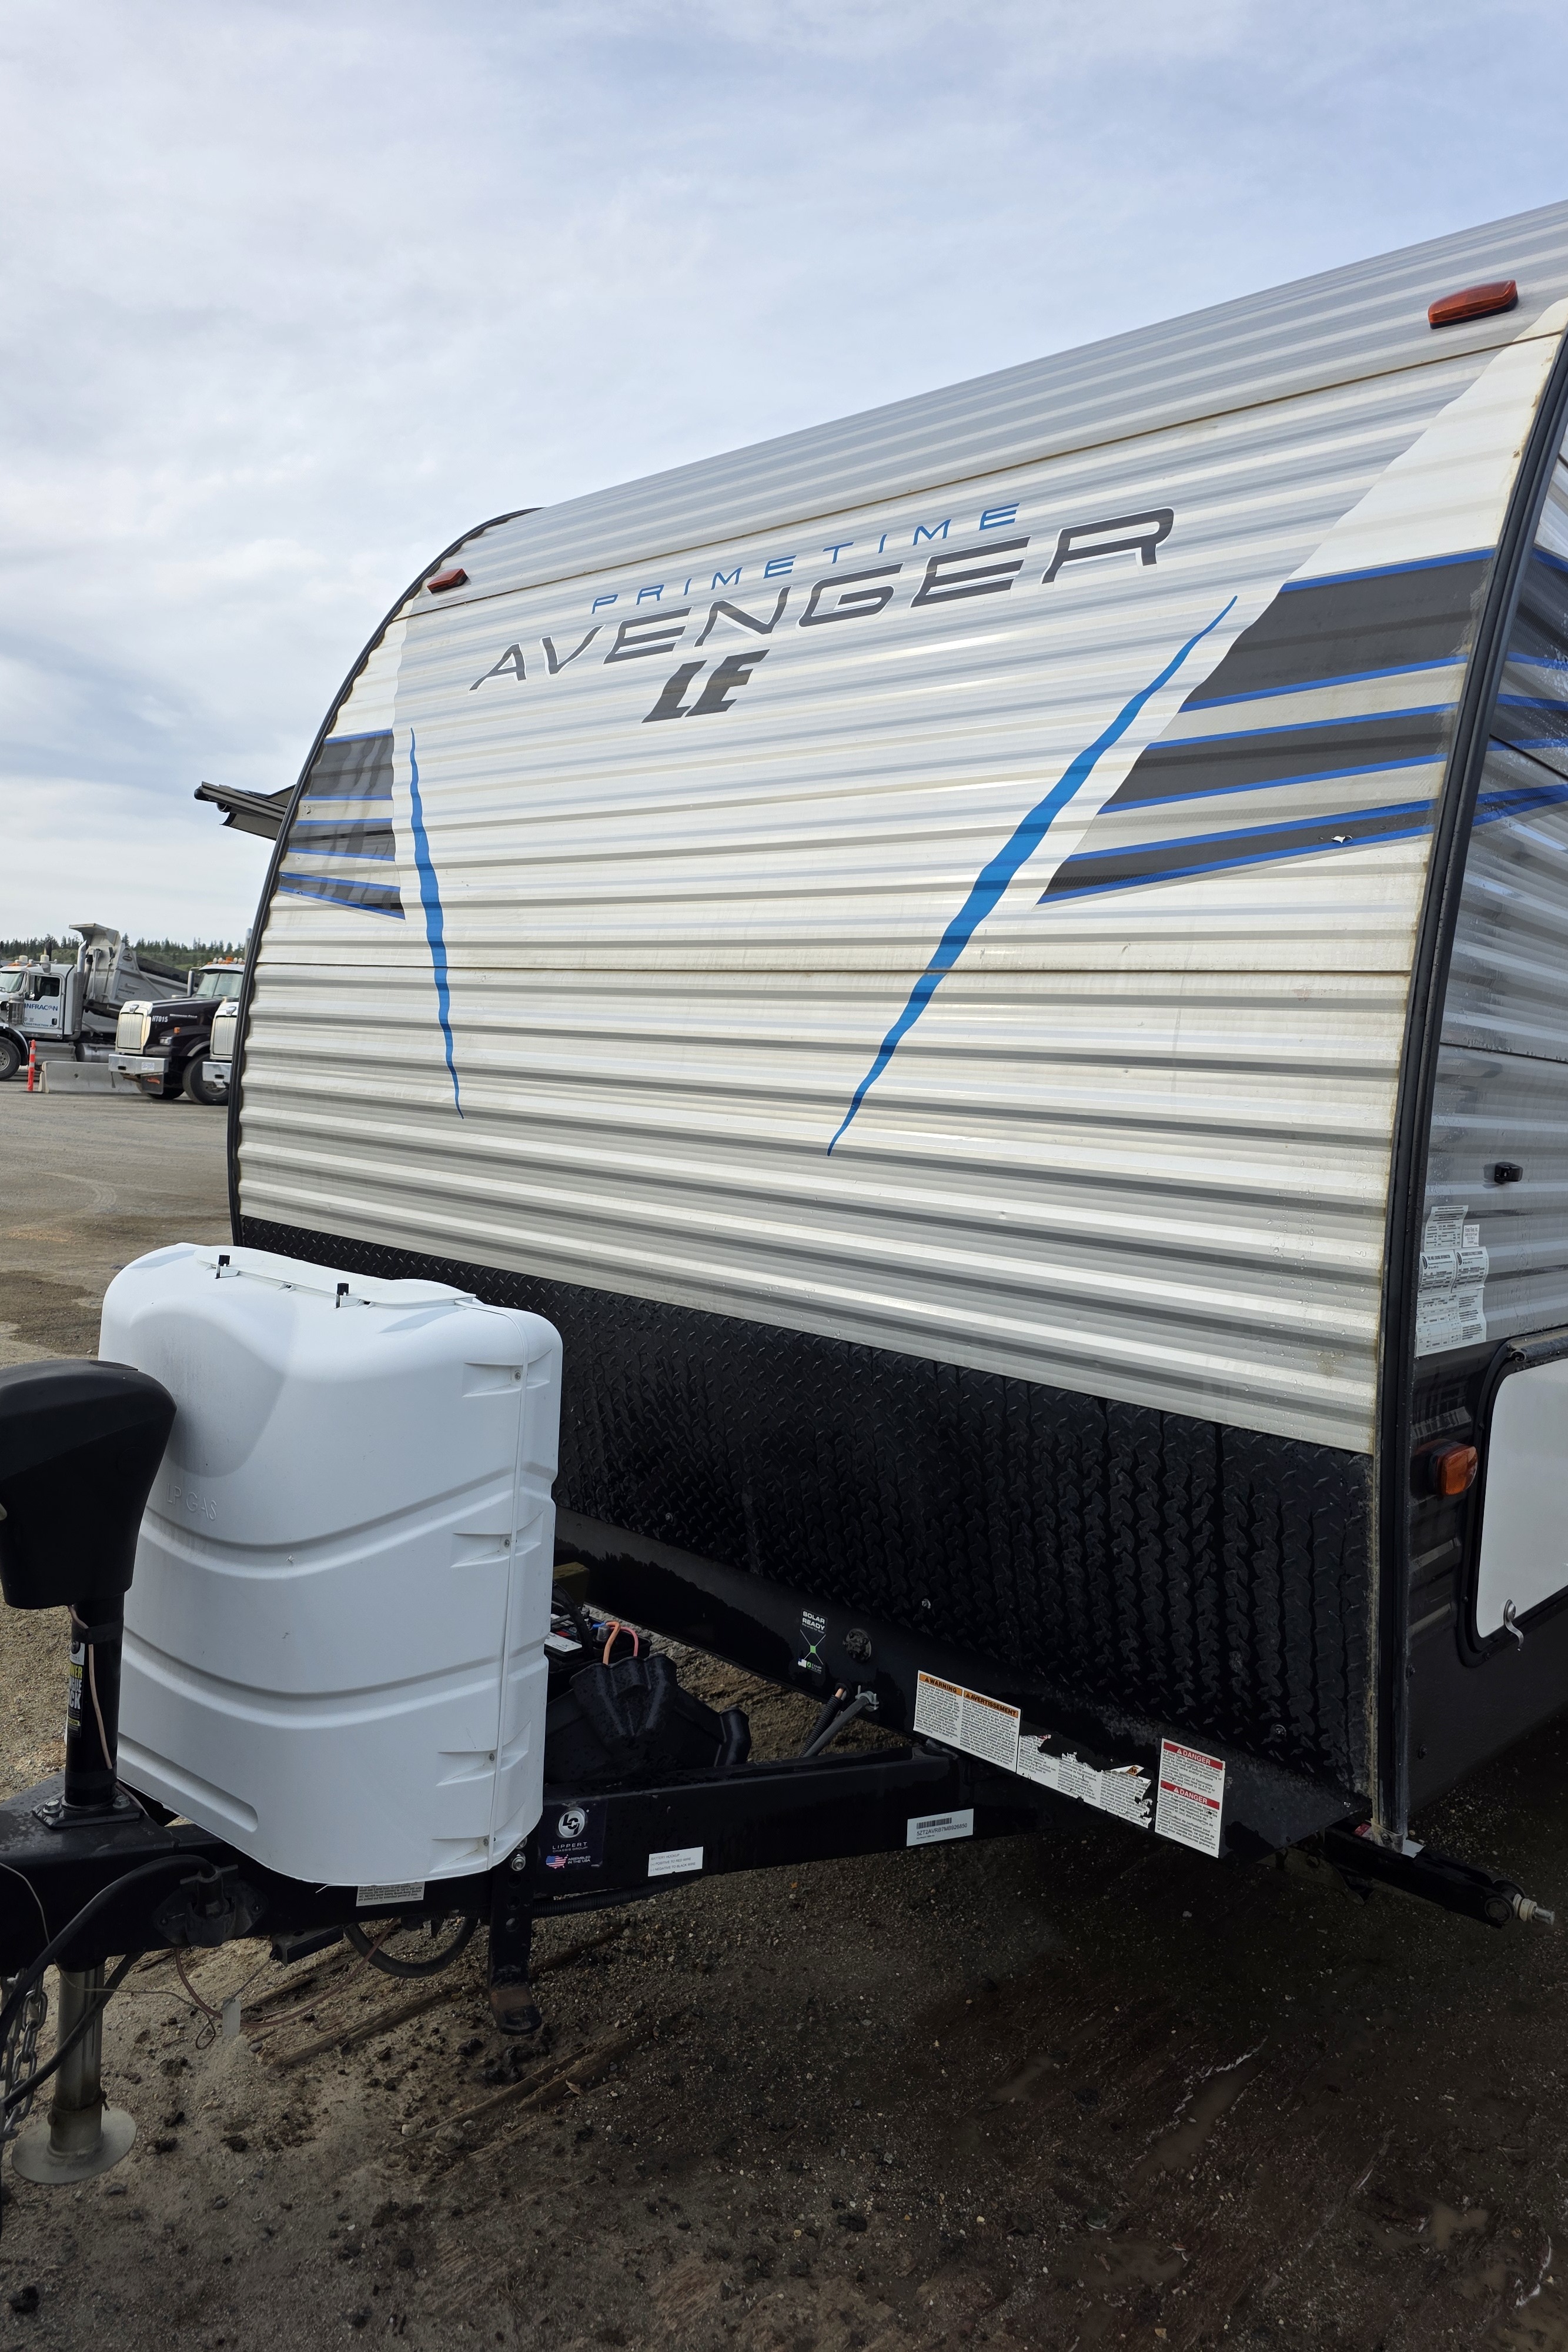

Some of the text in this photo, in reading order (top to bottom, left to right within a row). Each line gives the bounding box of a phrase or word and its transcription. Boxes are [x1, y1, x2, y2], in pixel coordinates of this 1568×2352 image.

[592, 503, 1020, 614] PRIMETIME
[470, 507, 1175, 691] AVENGER
[642, 649, 770, 723] LE
[168, 1483, 217, 1521] LP GAS
[802, 1618, 825, 1631] READY
[803, 1611, 825, 1624] SOLAR
[930, 1678, 957, 1693] WARNING
[971, 1694, 1017, 1716] AVERTISSEMENT
[1183, 1750, 1211, 1765] DANGER
[1180, 1789, 1207, 1804] DANGER
